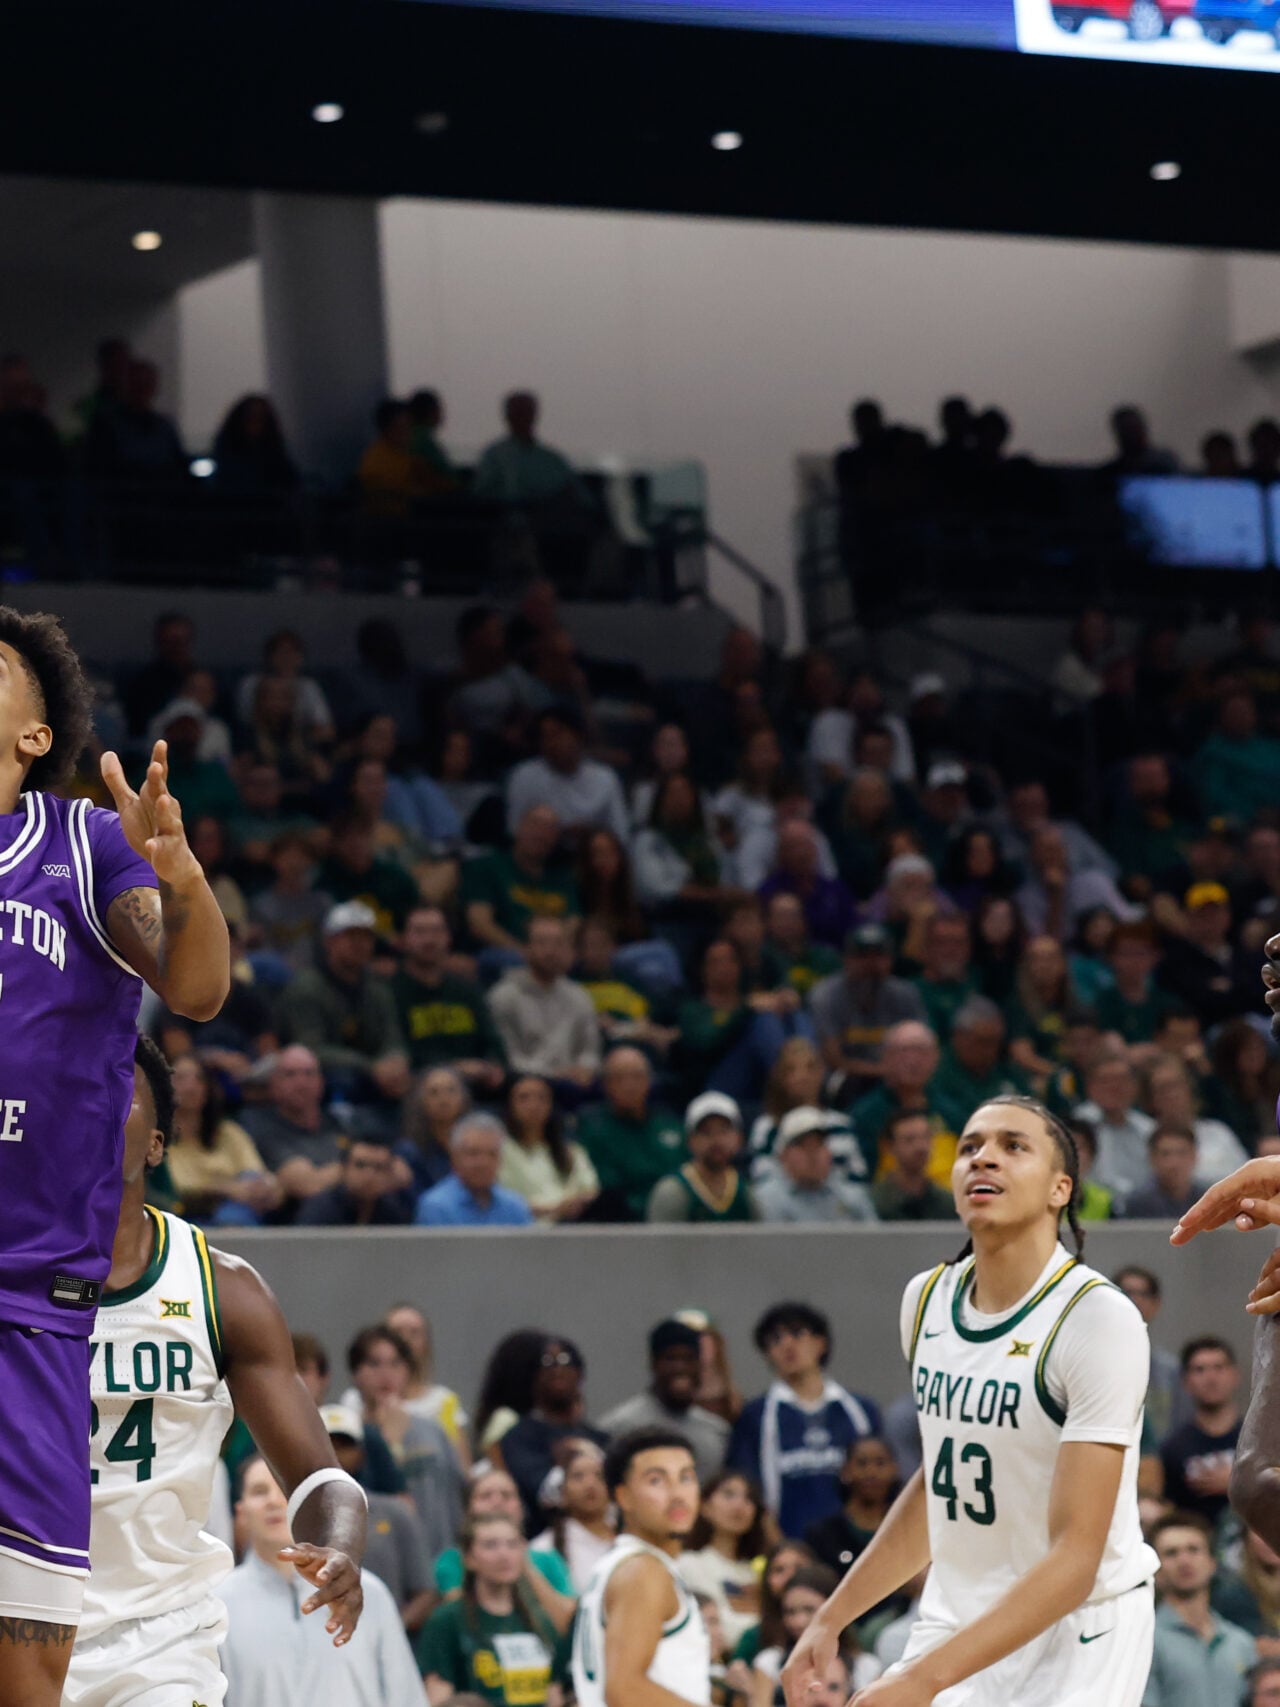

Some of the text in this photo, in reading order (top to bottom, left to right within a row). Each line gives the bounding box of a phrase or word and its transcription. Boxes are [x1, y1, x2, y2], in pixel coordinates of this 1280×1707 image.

[160, 1299, 192, 1318] XII
[916, 1366, 1022, 1429] BAYLOR
[932, 1436, 996, 1526] 43
